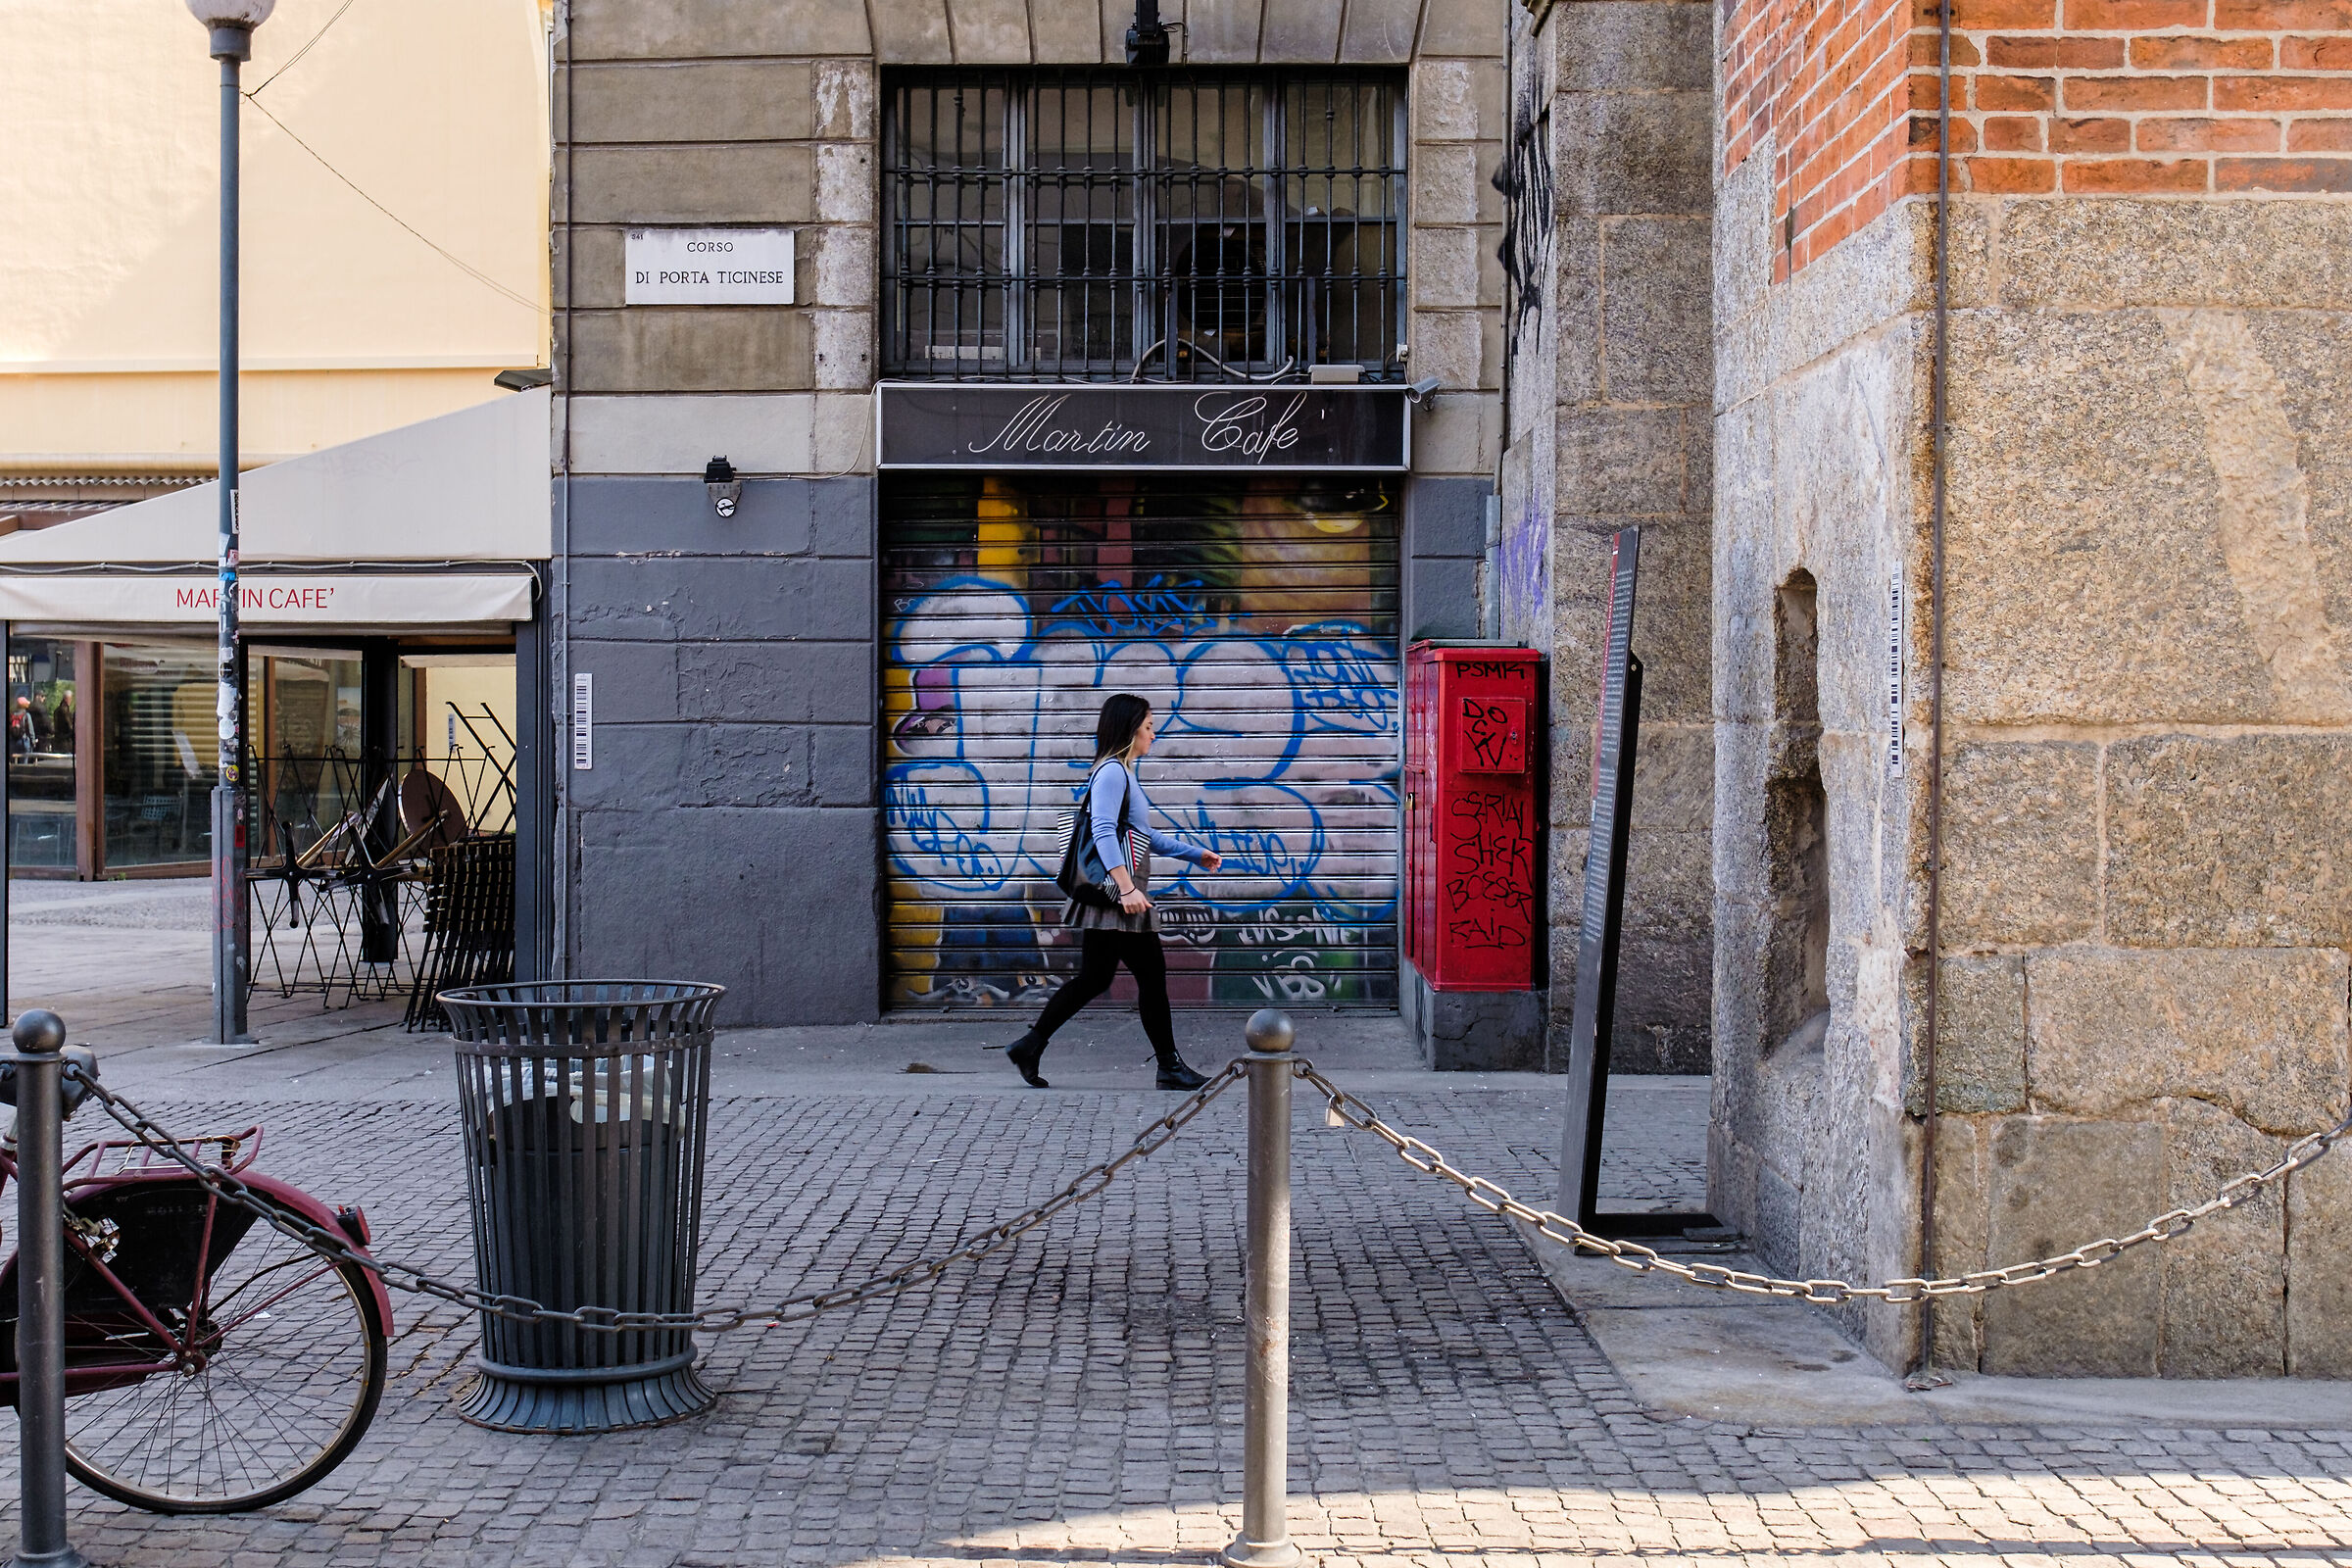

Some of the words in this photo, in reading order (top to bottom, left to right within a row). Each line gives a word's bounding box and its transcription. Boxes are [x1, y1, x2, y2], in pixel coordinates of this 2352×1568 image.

[687, 241, 734, 253] CORSO
[635, 270, 650, 284] DI
[660, 270, 710, 284] PORTA
[717, 270, 784, 284] TICINESE
[968, 393, 1151, 454] Martin
[176, 588, 263, 609] MAIN
[269, 587, 334, 610] CAFE'
